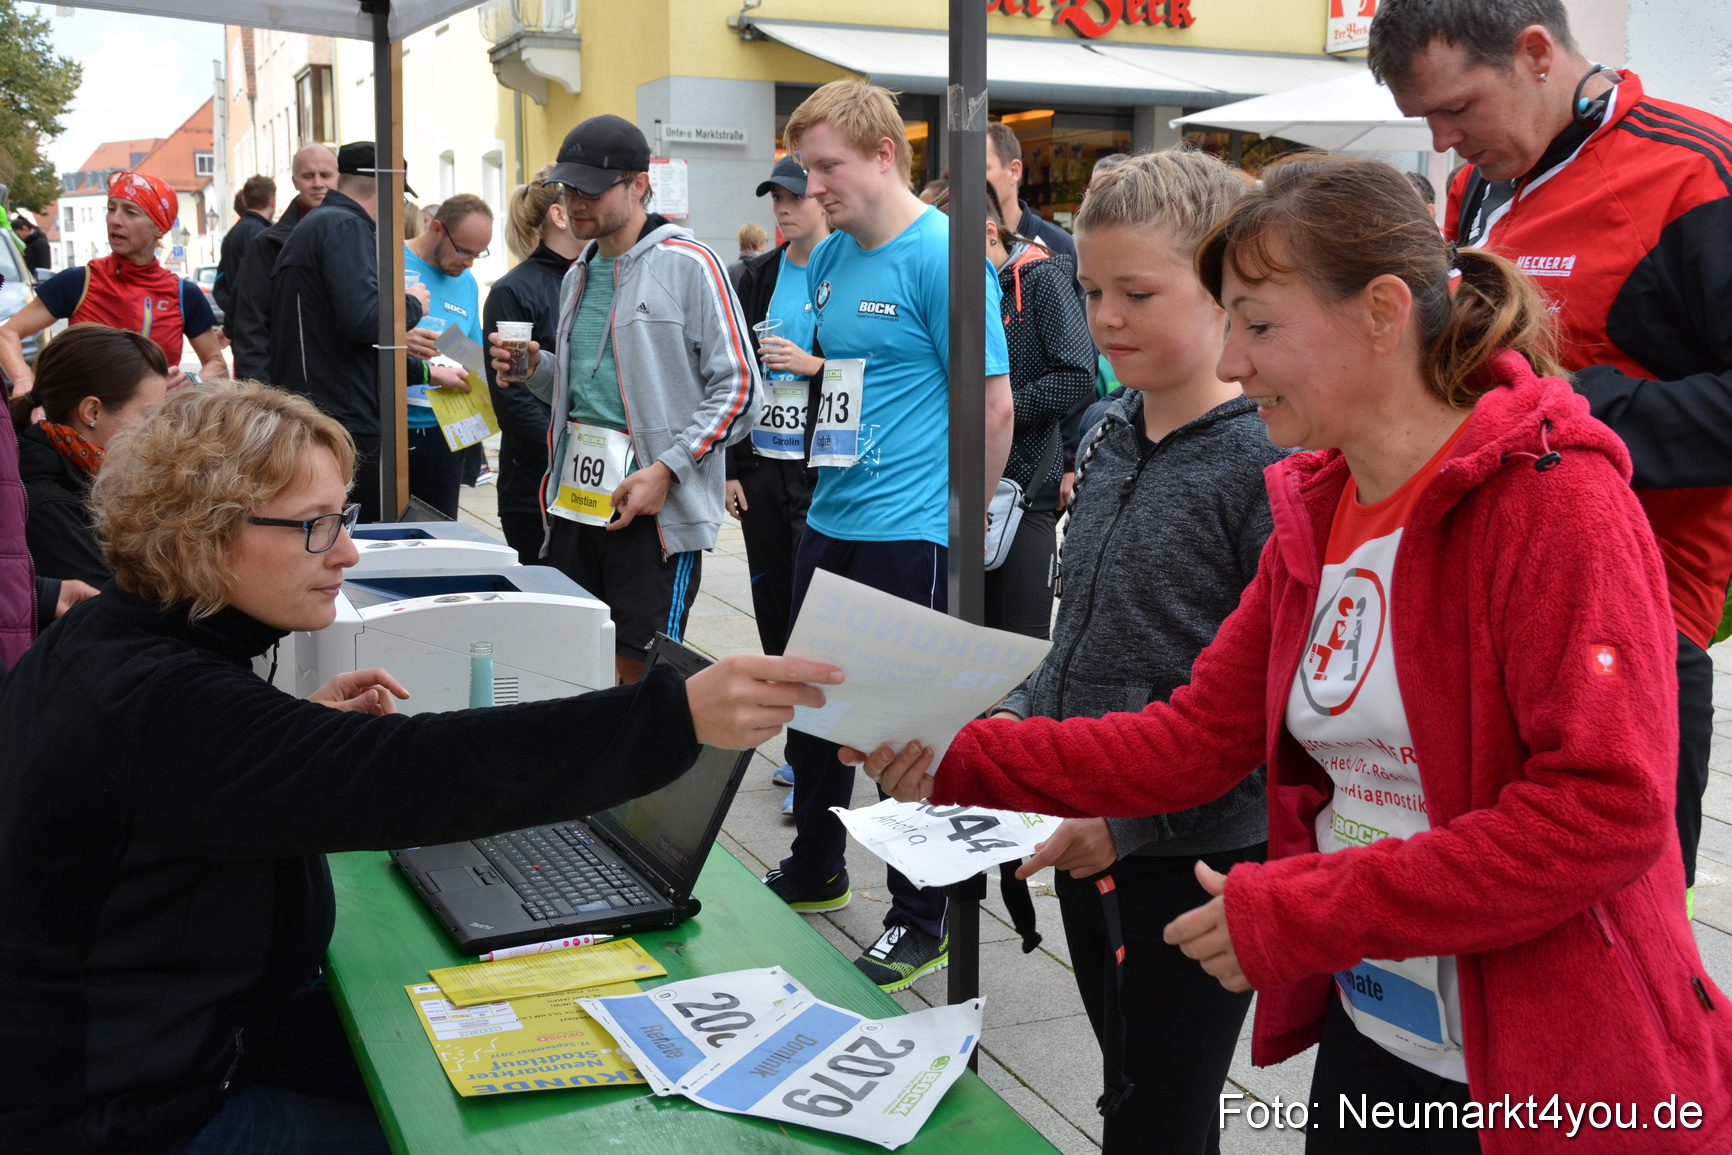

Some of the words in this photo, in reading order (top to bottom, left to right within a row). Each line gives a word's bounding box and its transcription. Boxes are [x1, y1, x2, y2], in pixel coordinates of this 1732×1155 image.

[695, 129, 744, 141] Marktstraße
[1516, 255, 1561, 270] HECKER
[444, 301, 468, 318] BOCK
[858, 300, 898, 316] BOCK
[772, 436, 800, 446] Carolin
[573, 454, 605, 487] 169
[570, 492, 598, 508] Christian
[524, 1043, 576, 1054] September
[640, 1023, 684, 1059] Renate
[491, 1049, 599, 1071] Stadtlauf
[748, 1033, 819, 1079] Dominik
[467, 1058, 605, 1081] Neumarkter
[781, 1036, 916, 1117] 2079
